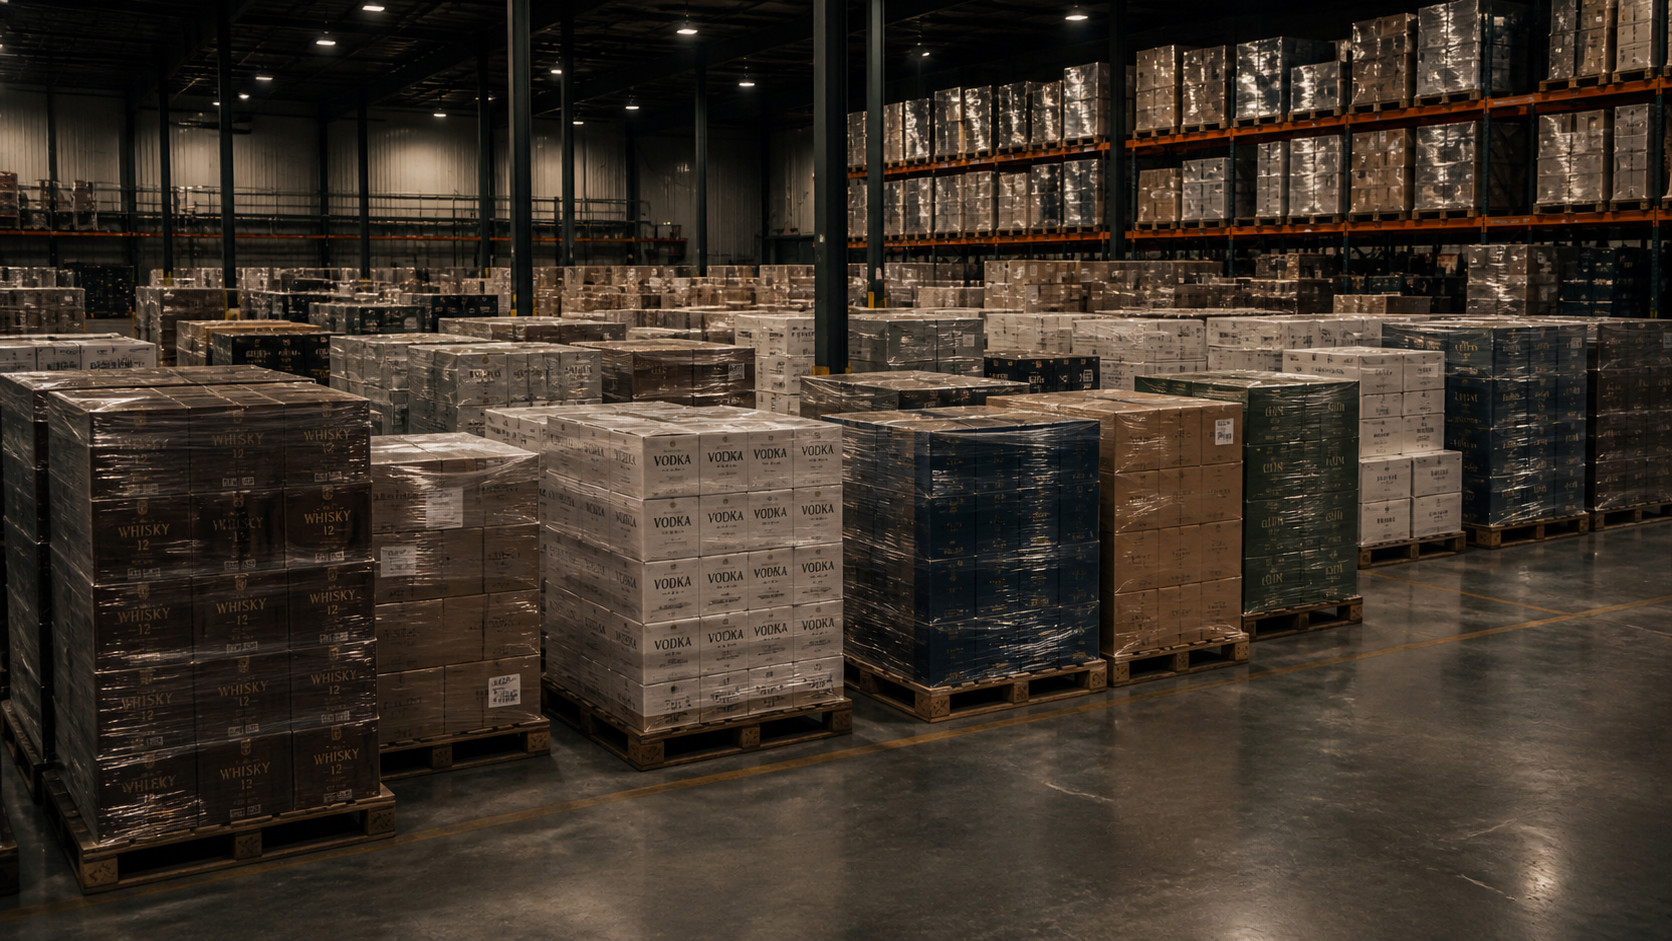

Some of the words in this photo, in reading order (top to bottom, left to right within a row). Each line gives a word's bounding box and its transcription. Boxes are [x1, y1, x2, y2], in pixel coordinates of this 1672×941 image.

[212, 432, 264, 447] WHISKY
[303, 428, 352, 441] WHISKY
[232, 449, 244, 458] 12
[707, 450, 744, 463] VODKA
[753, 447, 787, 460] VODKA
[801, 444, 834, 457] VODKA
[653, 454, 692, 467] VODKA
[753, 507, 788, 520] VODKA
[801, 503, 834, 516] VODKA
[303, 509, 352, 524] WHISKY
[653, 515, 692, 529] VODKA
[707, 510, 744, 523] VODKA
[117, 523, 171, 539] WHISKY
[323, 525, 335, 536] 12
[137, 540, 149, 551] 12
[753, 566, 788, 579] VODKA
[801, 560, 835, 574] VODKA
[653, 576, 692, 590] VODKA
[707, 570, 744, 584] VODKA
[309, 589, 356, 604] WHISKY
[216, 598, 267, 614] WHISKY
[327, 605, 339, 615] 12
[117, 607, 171, 623] WHISKY
[237, 615, 249, 626] 12
[138, 624, 151, 635] 12
[753, 622, 788, 637] VODKA
[801, 617, 835, 631] VODKA
[707, 629, 744, 643] VODKA
[654, 636, 692, 651] VODKA
[310, 669, 357, 685] WHISKY
[218, 680, 269, 697] WHISKY
[329, 685, 341, 695] 12
[121, 692, 173, 710] WHISKY
[239, 696, 250, 707] 12
[141, 710, 154, 721] 12
[313, 748, 360, 766] WHISKY
[219, 762, 271, 780] WHISKY
[330, 764, 343, 776] 12
[240, 779, 253, 790] 12
